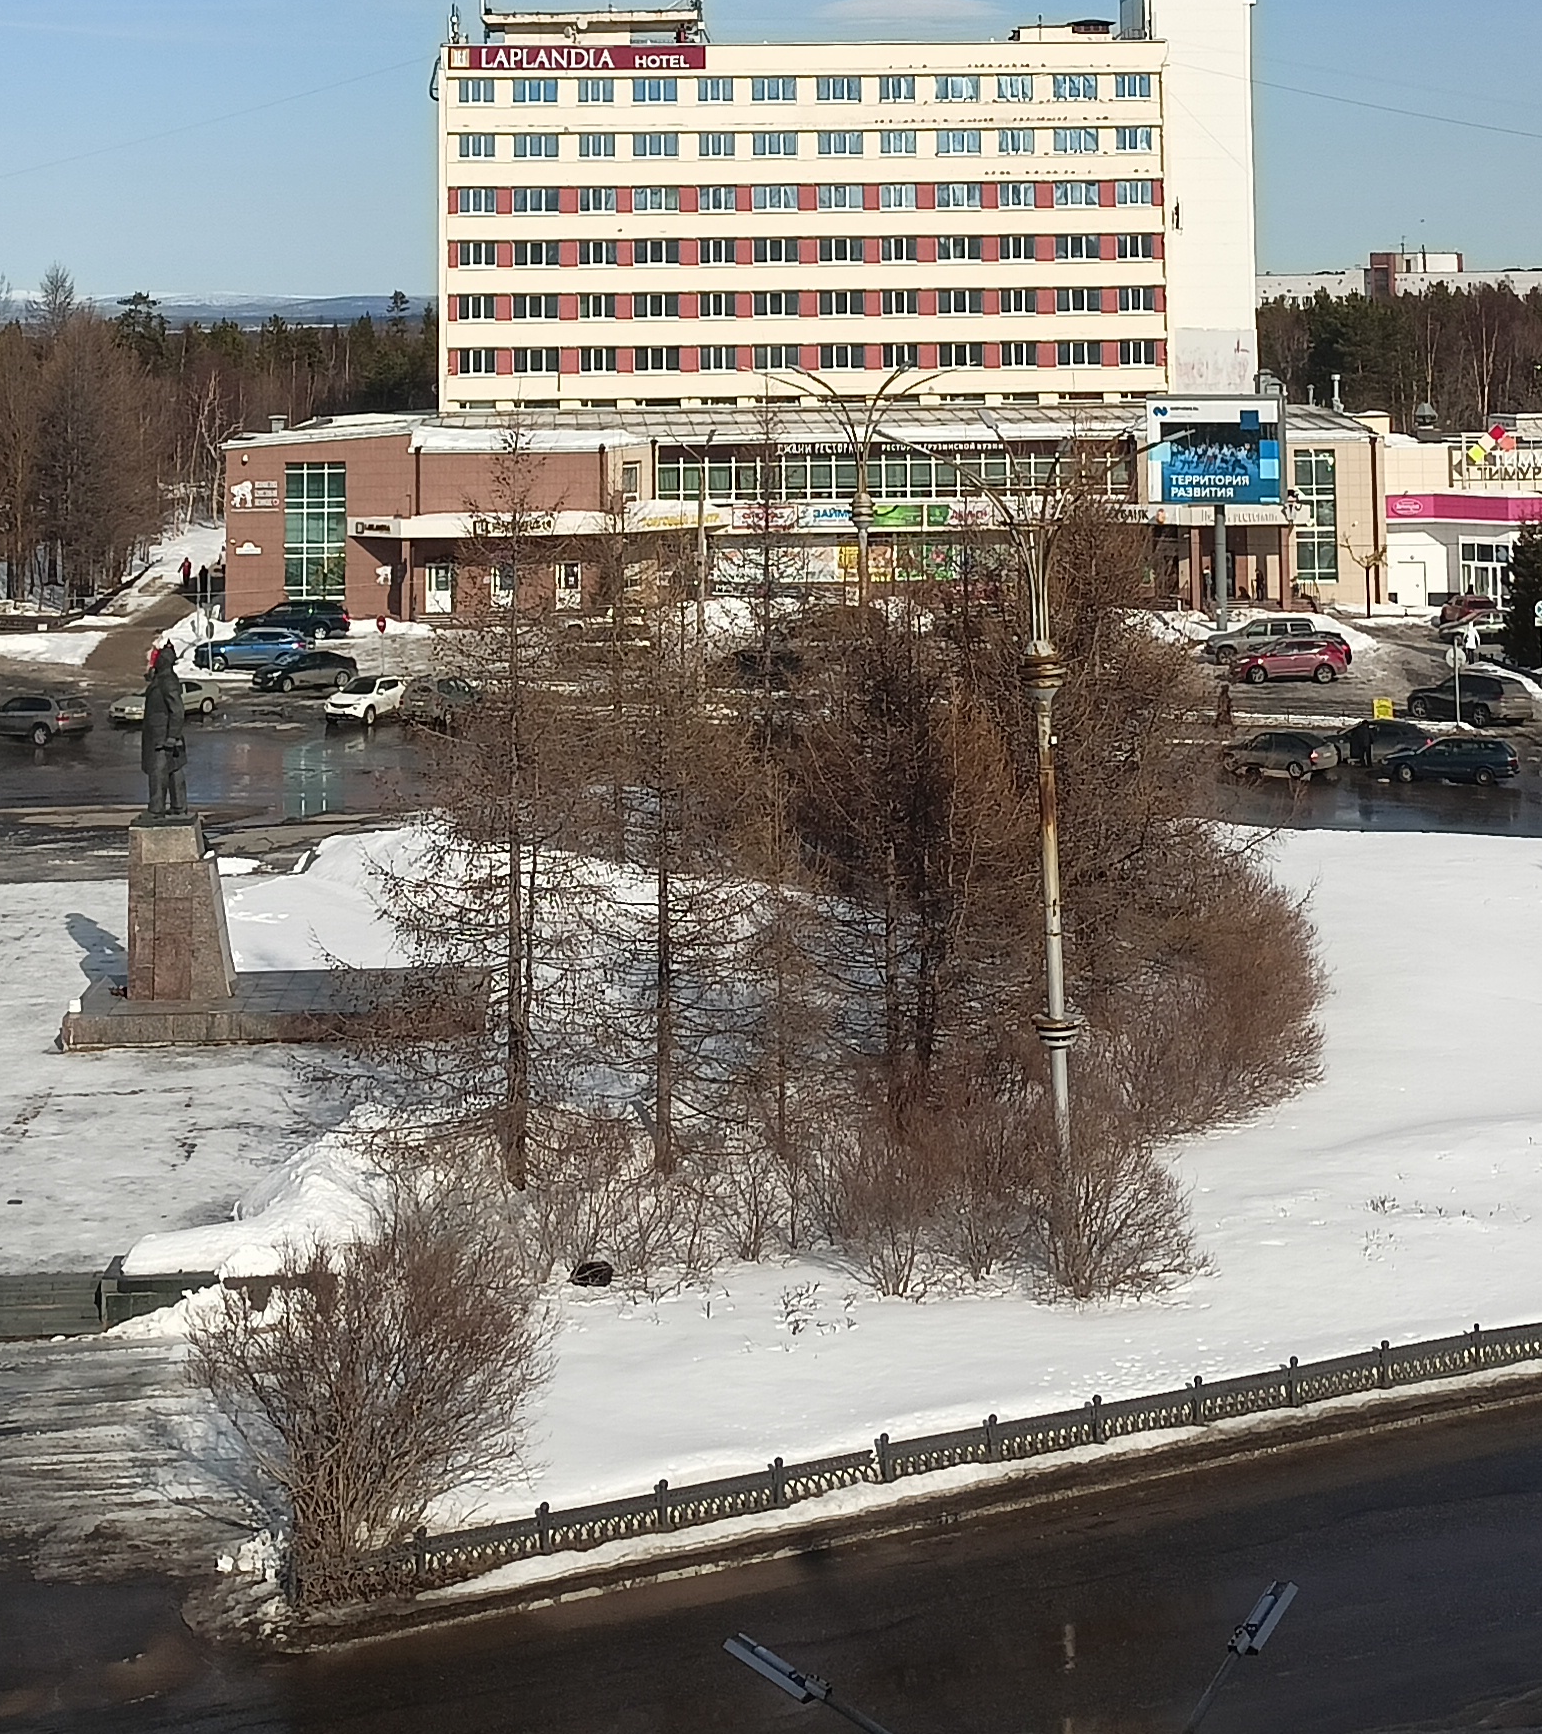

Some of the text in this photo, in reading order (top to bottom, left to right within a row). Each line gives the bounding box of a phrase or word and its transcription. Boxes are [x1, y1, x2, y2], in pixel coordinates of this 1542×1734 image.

[481, 48, 689, 69] LAPLANDIA HOTEL
[1170, 474, 1250, 486] ТЕРРИТОРИЯ
[1170, 487, 1234, 498] РАЗВИТИЯ
